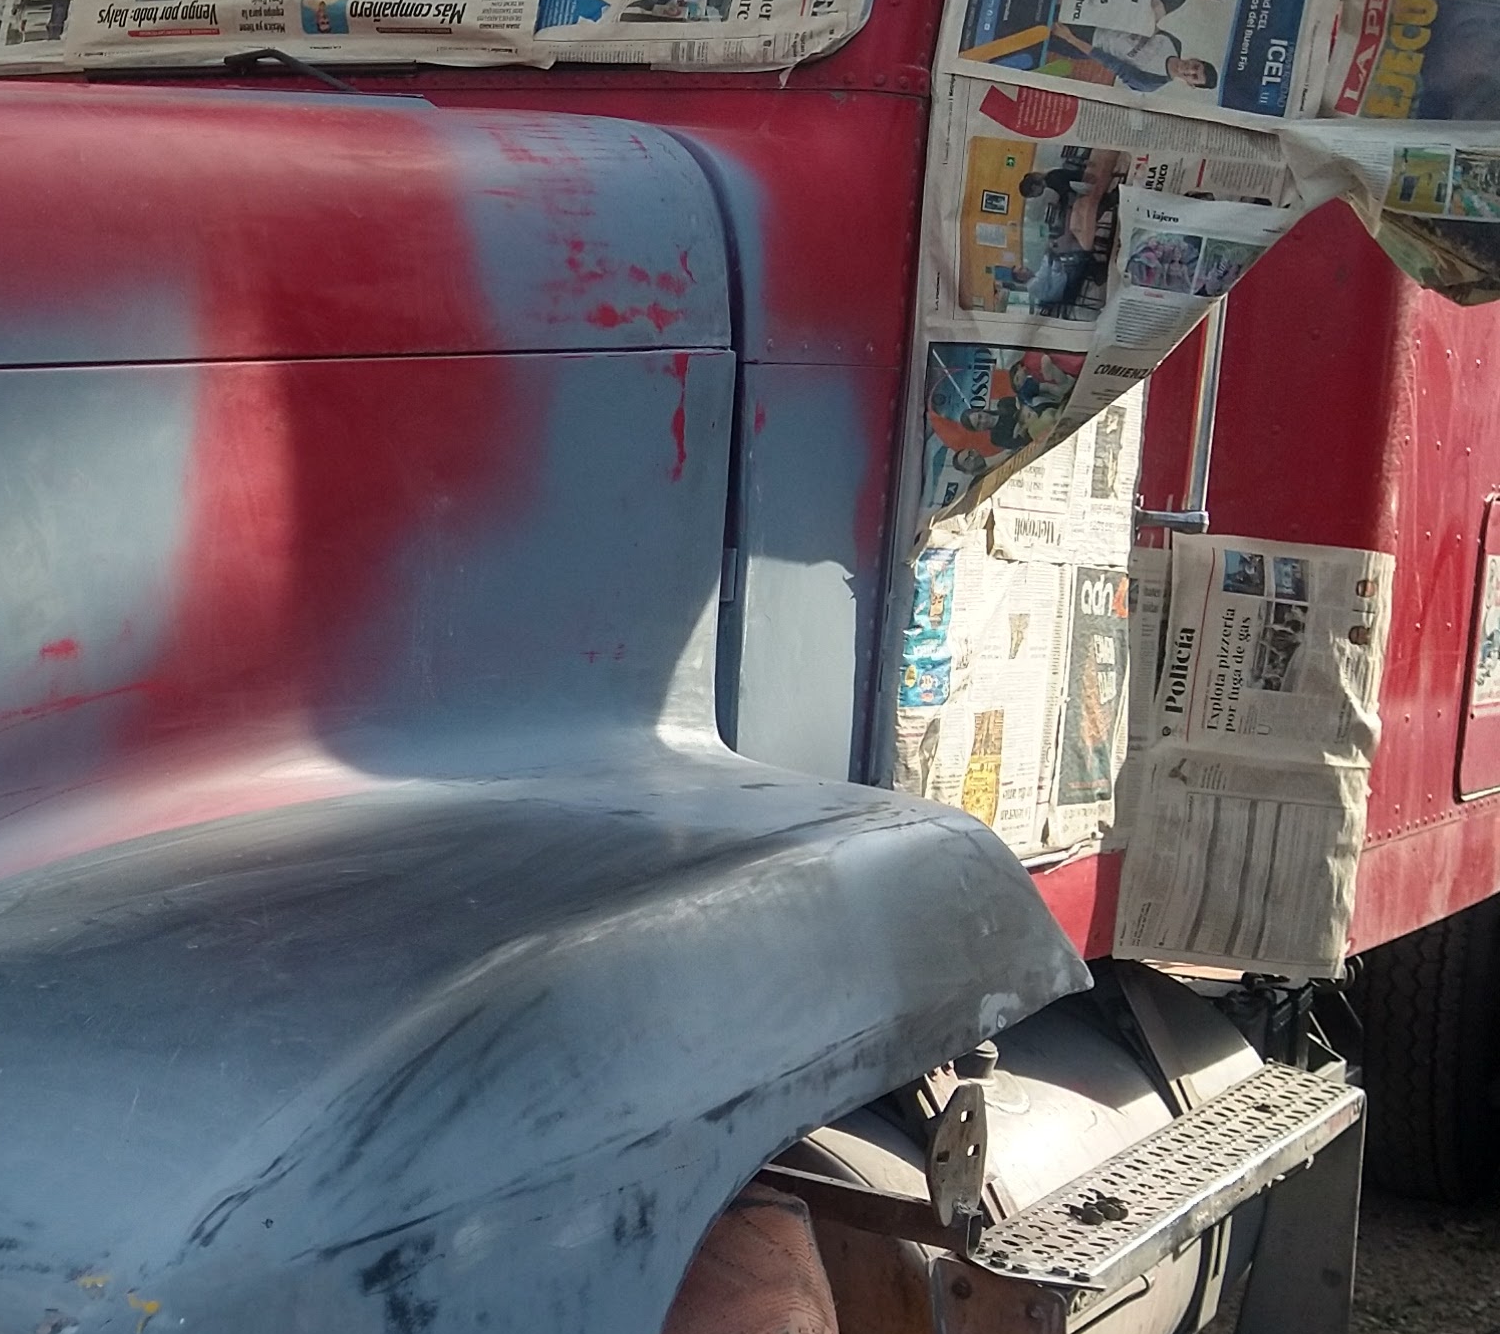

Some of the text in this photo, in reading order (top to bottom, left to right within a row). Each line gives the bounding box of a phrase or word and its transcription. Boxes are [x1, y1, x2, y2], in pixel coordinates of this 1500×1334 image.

[98, 0, 218, 29] Vengo por todo: Dalys
[241, 5, 284, 19] equipo para la
[432, 1, 466, 23] Más
[1247, 11, 1255, 27] del
[1256, 8, 1267, 30] ICEL
[239, 21, 286, 34] México ya tiene
[1242, 28, 1254, 56] Buen
[1237, 56, 1247, 71] Fin
[1262, 38, 1288, 87] ICEL
[1344, 43, 1374, 101] LA
[1148, 166, 1158, 179] LA
[1146, 208, 1179, 225] Viajero
[1164, 627, 1196, 714] Policía
[1207, 607, 1236, 731] Explota pizzería
[1225, 615, 1252, 732] por fuga de gas
